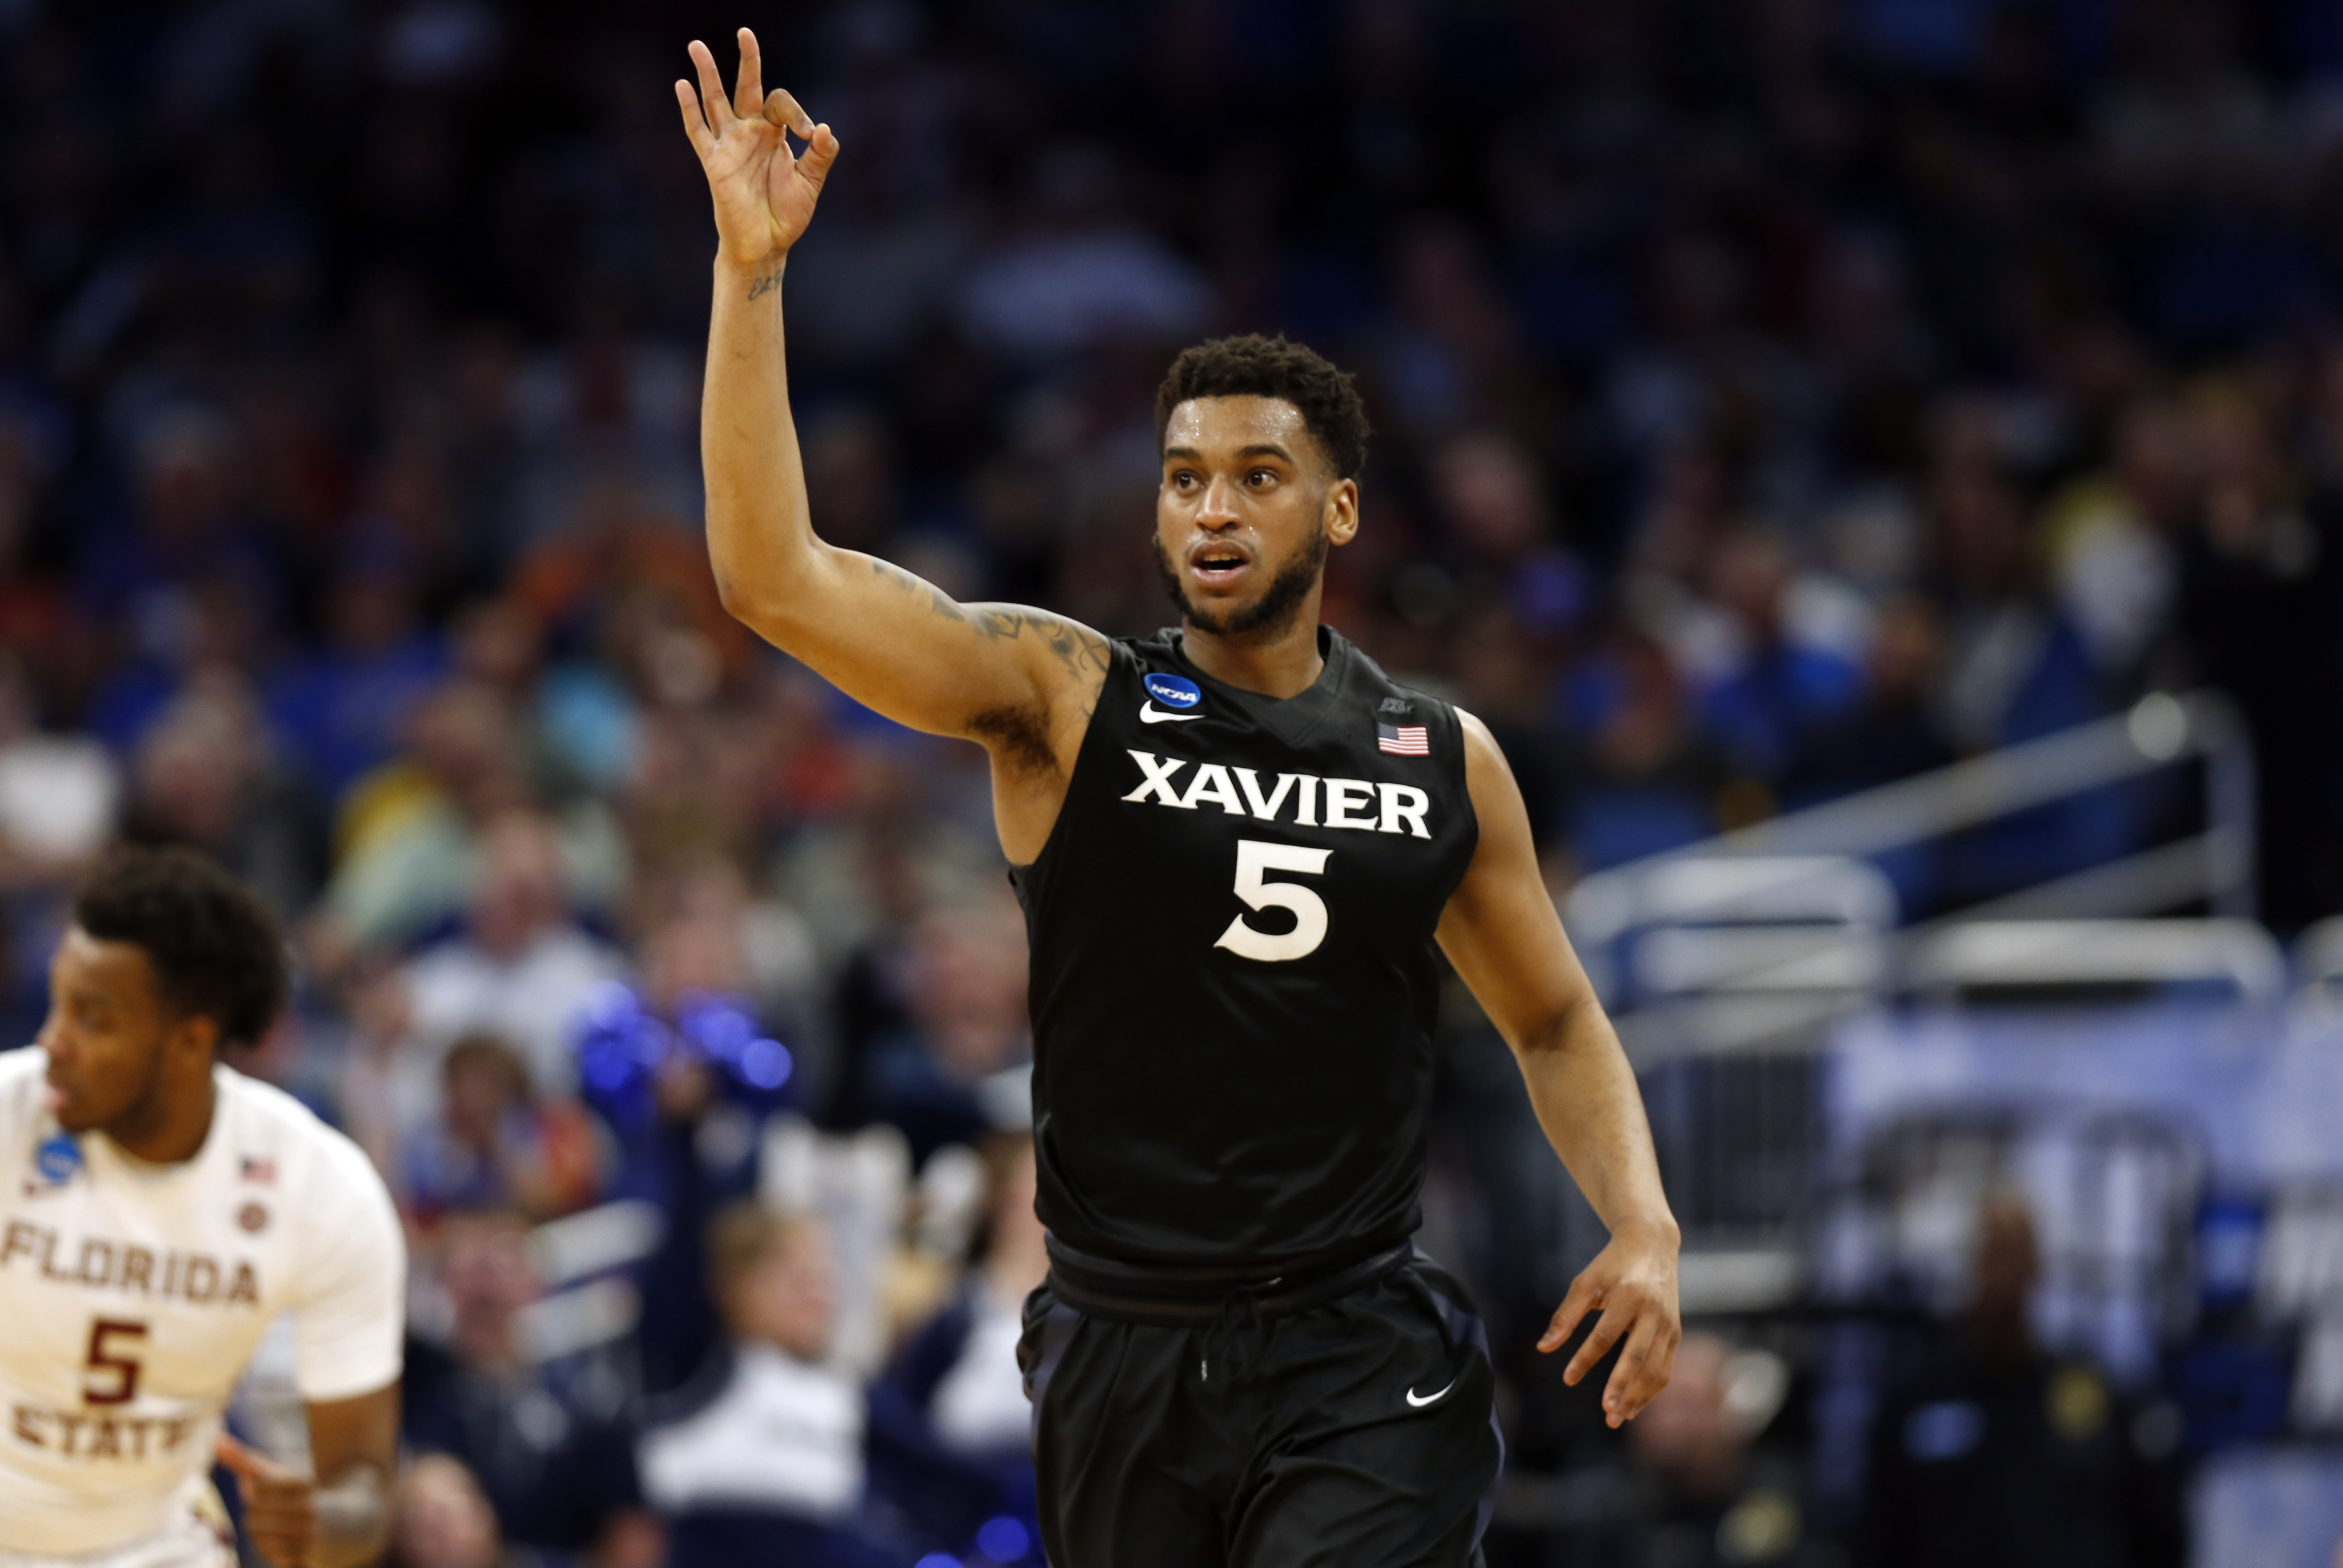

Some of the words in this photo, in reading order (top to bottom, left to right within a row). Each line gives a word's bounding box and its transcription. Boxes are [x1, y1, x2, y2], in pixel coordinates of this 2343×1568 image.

[1151, 683, 1197, 702] NCAA
[1121, 749, 1432, 840] XAVIER
[1213, 839, 1334, 962] 5
[0, 1220, 259, 1304] FLORIDA
[84, 1319, 149, 1403] 5
